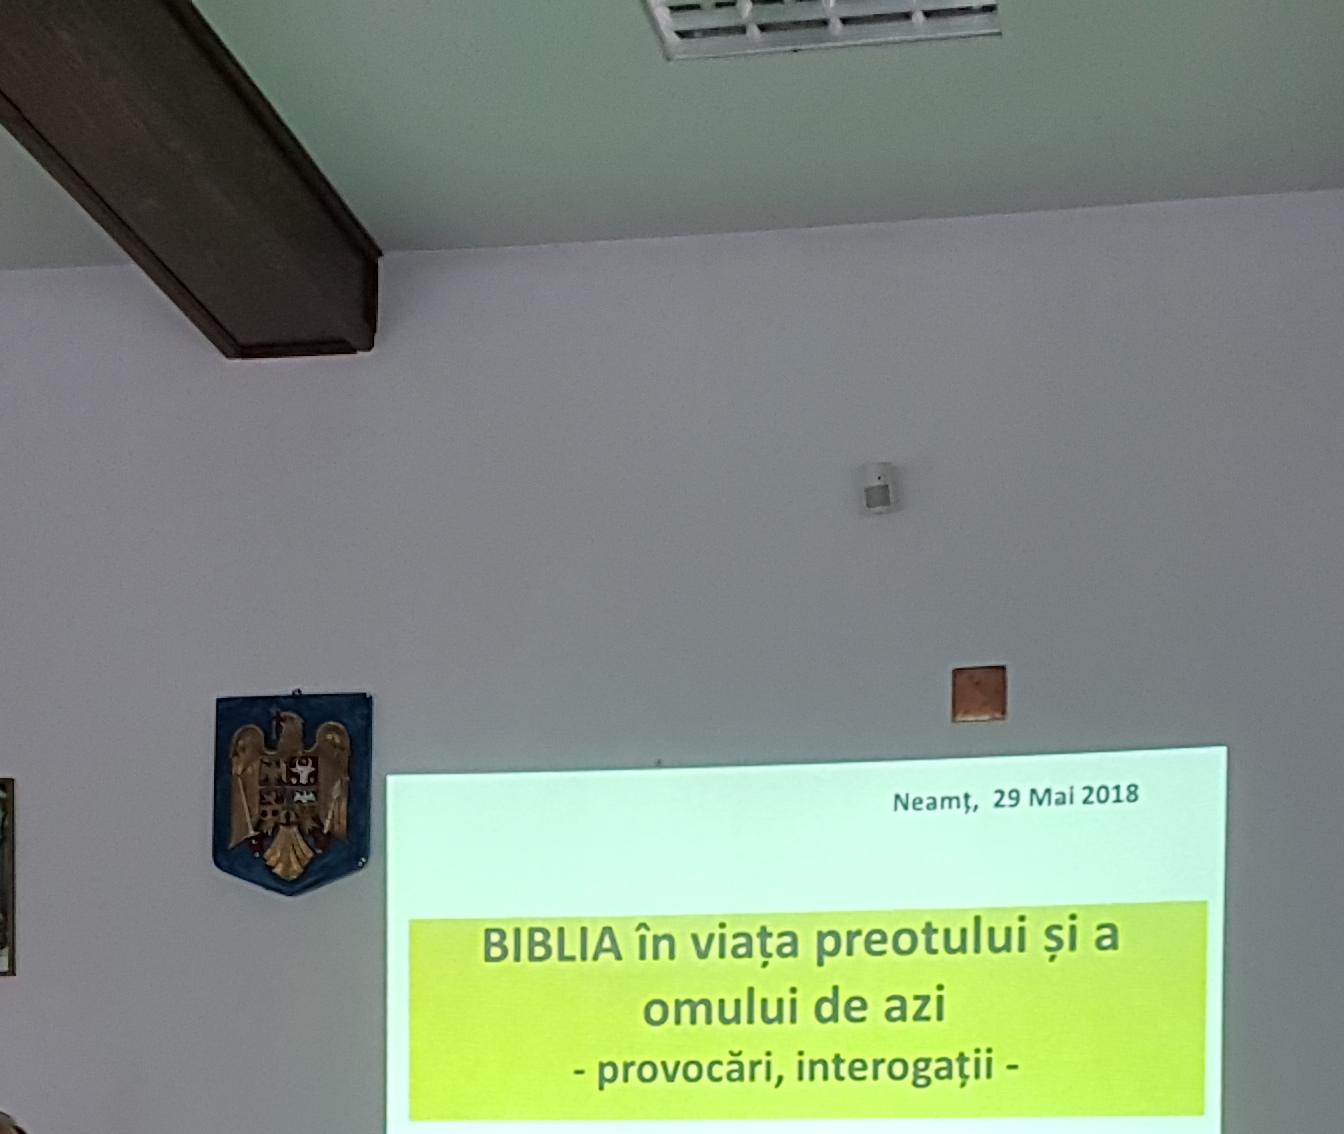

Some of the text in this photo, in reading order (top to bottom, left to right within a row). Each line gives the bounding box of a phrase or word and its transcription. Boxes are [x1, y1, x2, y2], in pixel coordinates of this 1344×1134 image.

[993, 788, 1021, 809] 29
[1029, 785, 1074, 807] Mai
[1081, 783, 1139, 805] 2018
[483, 912, 1119, 969] BIBLIA în viața preotului și a
[643, 983, 945, 1027] omului de azi
[597, 1049, 784, 1092] provocări,
[797, 1047, 993, 1089] interogații
